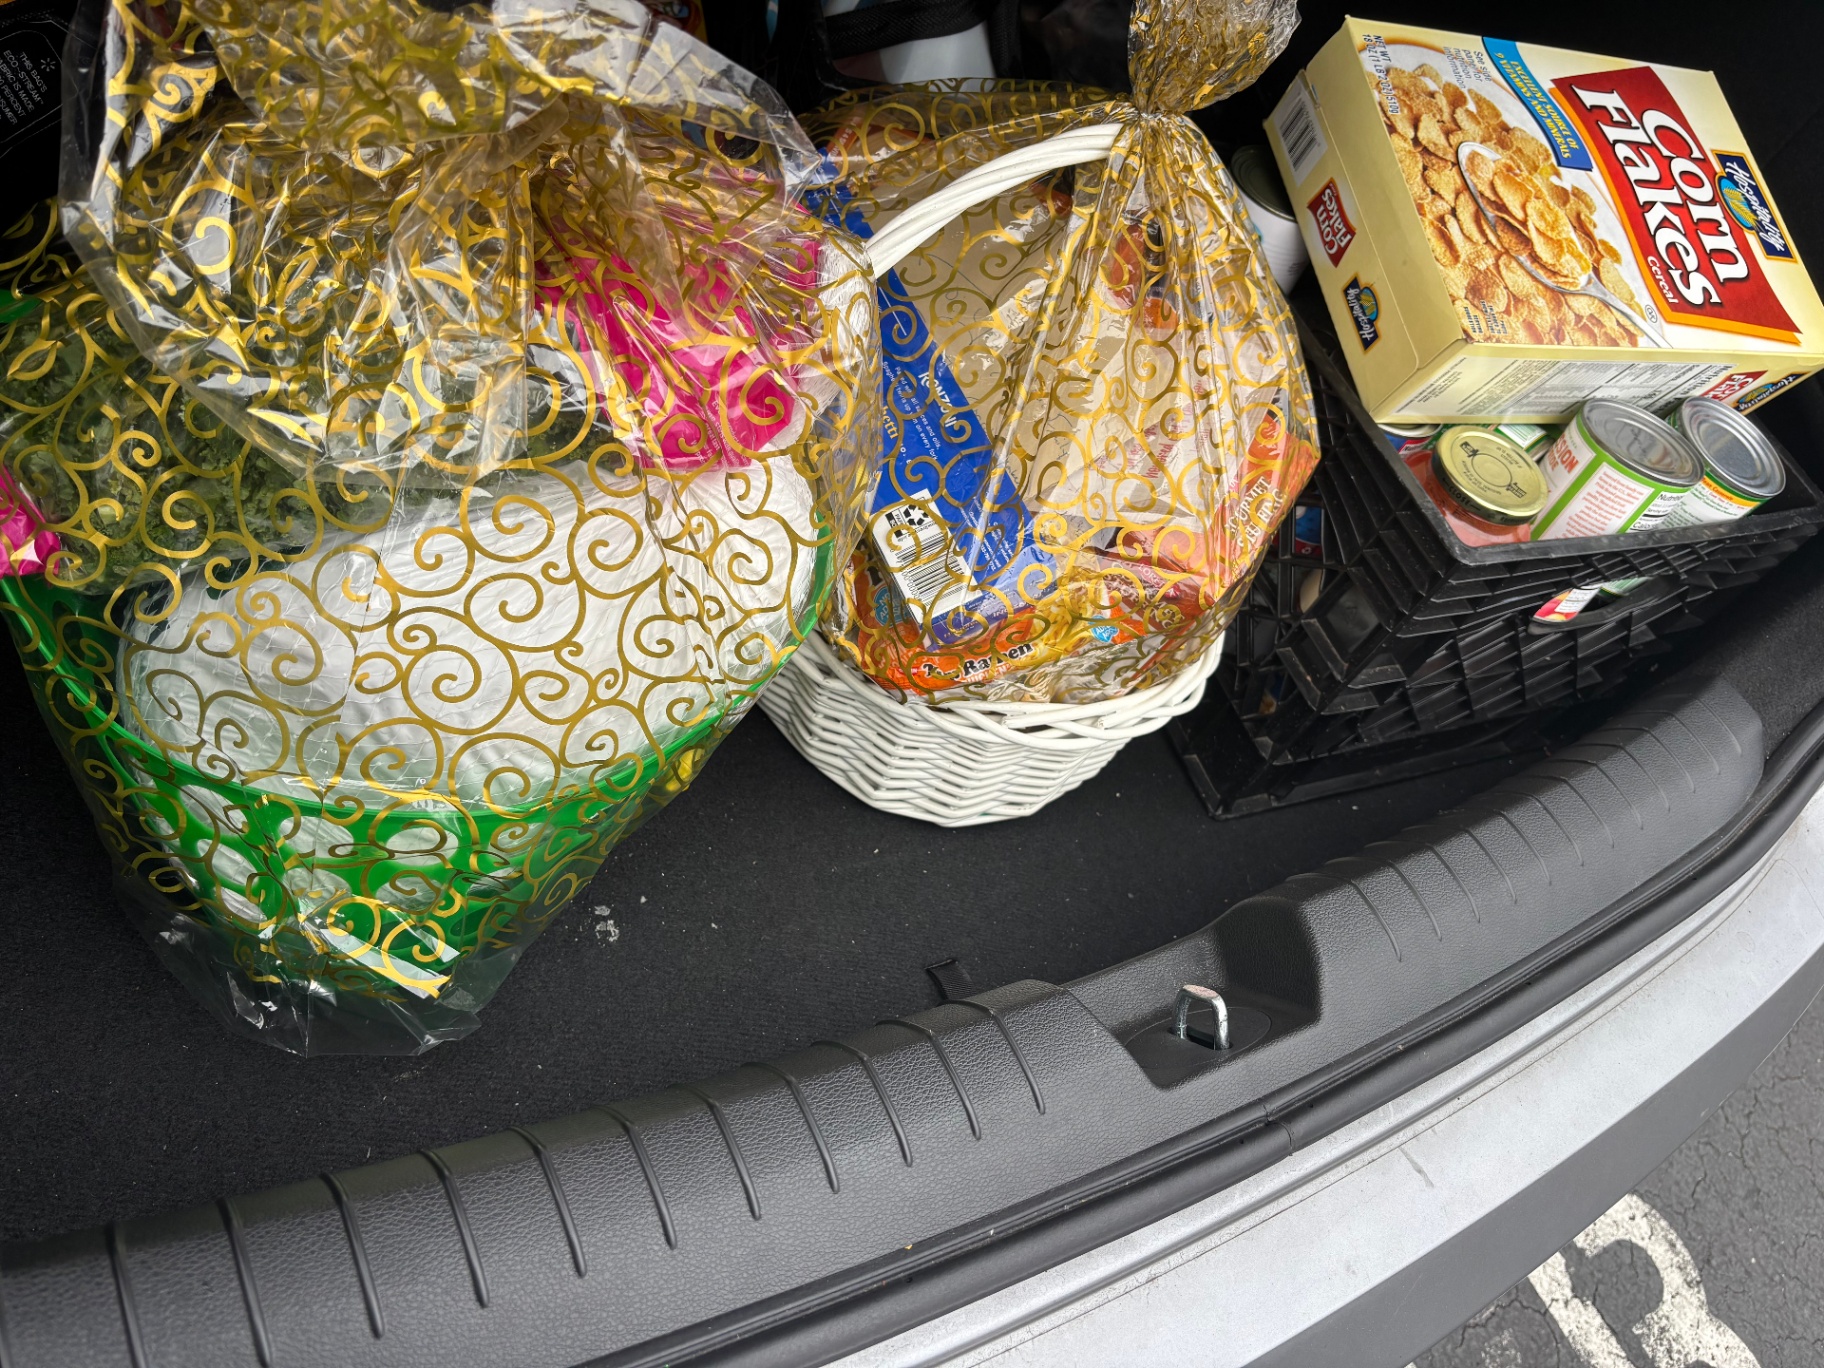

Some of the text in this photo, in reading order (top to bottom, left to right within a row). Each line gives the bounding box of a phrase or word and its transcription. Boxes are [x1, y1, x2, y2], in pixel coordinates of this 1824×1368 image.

[1362, 34, 1372, 42] 18
[1366, 43, 1377, 53] OZ
[1373, 35, 1391, 61] NET WT
[19, 51, 48, 93] THIS BAG'S
[1368, 54, 1380, 62] (1
[1374, 64, 1385, 73] LB
[1443, 46, 1466, 89] information
[1453, 47, 1472, 79] nutrition
[1461, 49, 1482, 81] panel for
[1473, 51, 1492, 82] See side
[0, 83, 26, 117] PERCENT
[11, 81, 21, 91] IS
[17, 89, 35, 112] MADE
[1381, 82, 1394, 93] OZ)
[1386, 95, 1399, 113] 510g
[1497, 59, 1533, 97] VITAMINS
[1528, 98, 1549, 116] AND
[1540, 118, 1571, 159] MINERALS
[1509, 60, 1580, 149] EXCELLENT SOURCE OF
[1571, 84, 1722, 306] Flakes
[1641, 109, 1748, 282] Corn
[1726, 160, 1784, 251] Hospitality
[1316, 202, 1337, 254] Corn
[1322, 187, 1352, 247] Flakes
[1647, 254, 1678, 304] Cereal
[1346, 287, 1375, 337] Hospitality
[913, 405, 930, 426] saces
[924, 424, 936, 437] and
[917, 431, 933, 449] every
[1446, 484, 1471, 506] CLOSE
